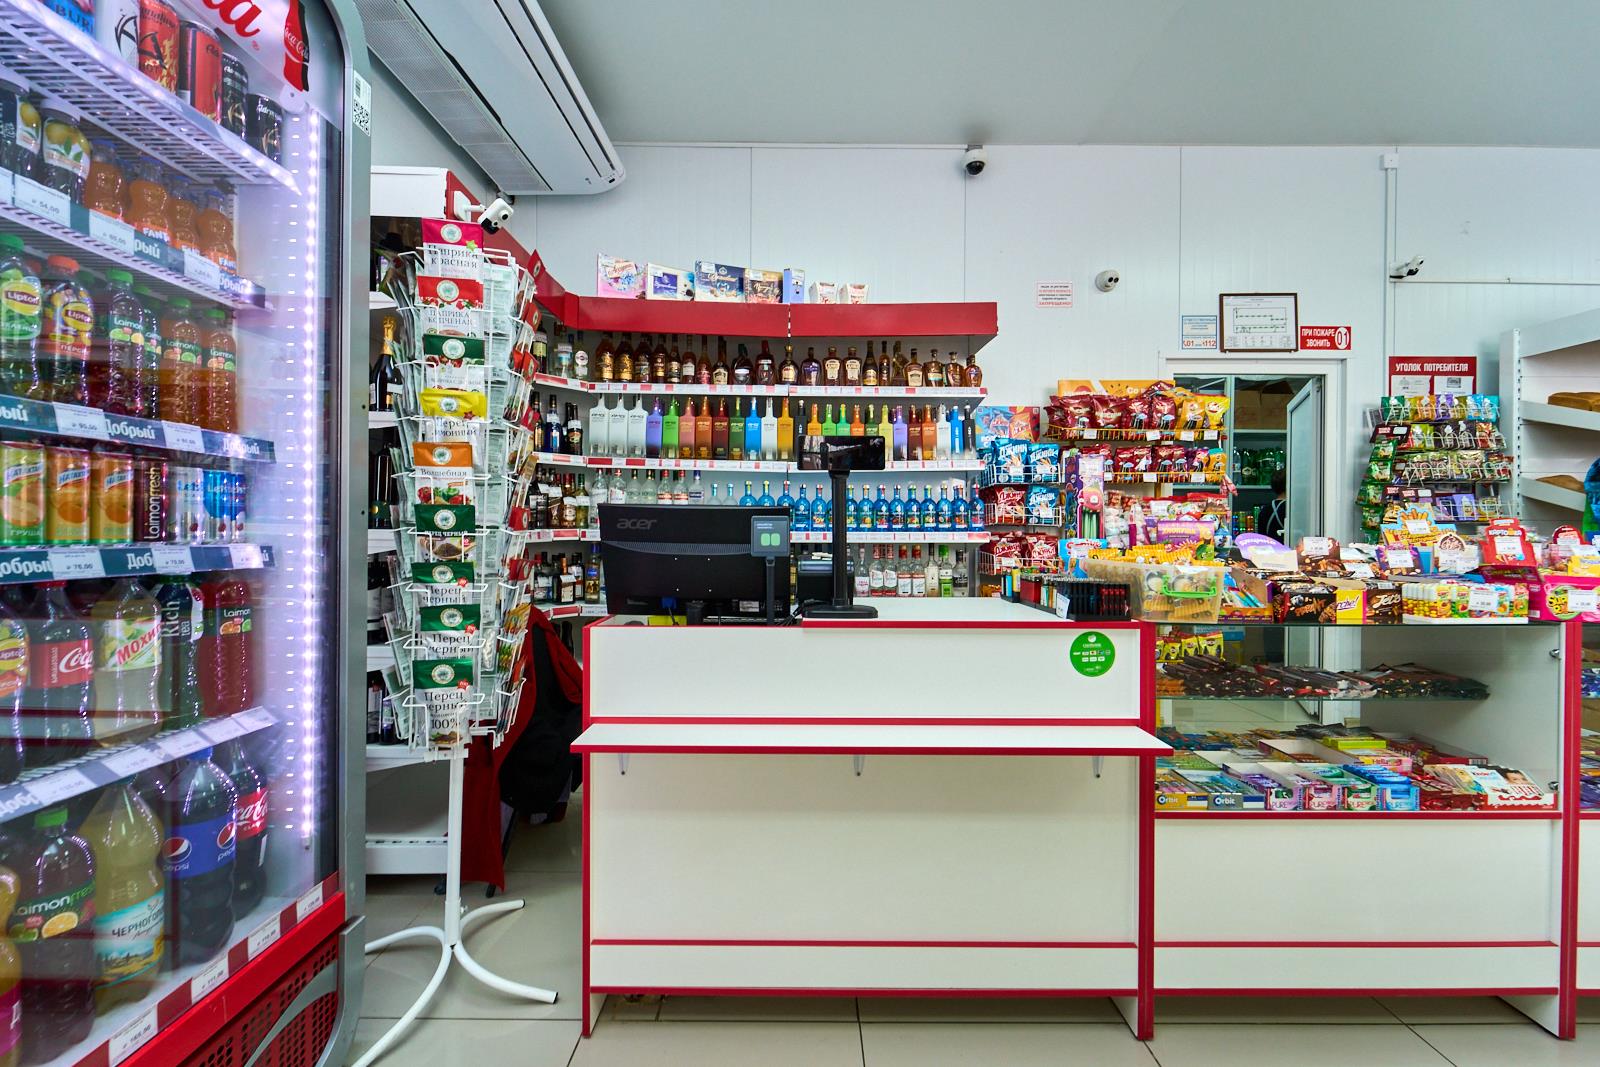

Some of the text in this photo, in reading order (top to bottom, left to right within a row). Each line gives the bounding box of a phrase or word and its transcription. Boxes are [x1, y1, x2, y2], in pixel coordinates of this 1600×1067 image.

[1301, 328, 1336, 337] ПРИ ПОЖАРЕ
[1336, 330, 1349, 347] 01
[1306, 339, 1331, 347] ЗВОНИТЬ
[1395, 363, 1469, 373] УГОЛОК ПОТРЕБИТЕЛЯ
[616, 518, 657, 530] acer
[161, 601, 181, 638] Rich
[180, 620, 191, 637] tea
[432, 633, 470, 647] Перец
[424, 690, 464, 703] Перец
[1272, 800, 1288, 808] PURE
